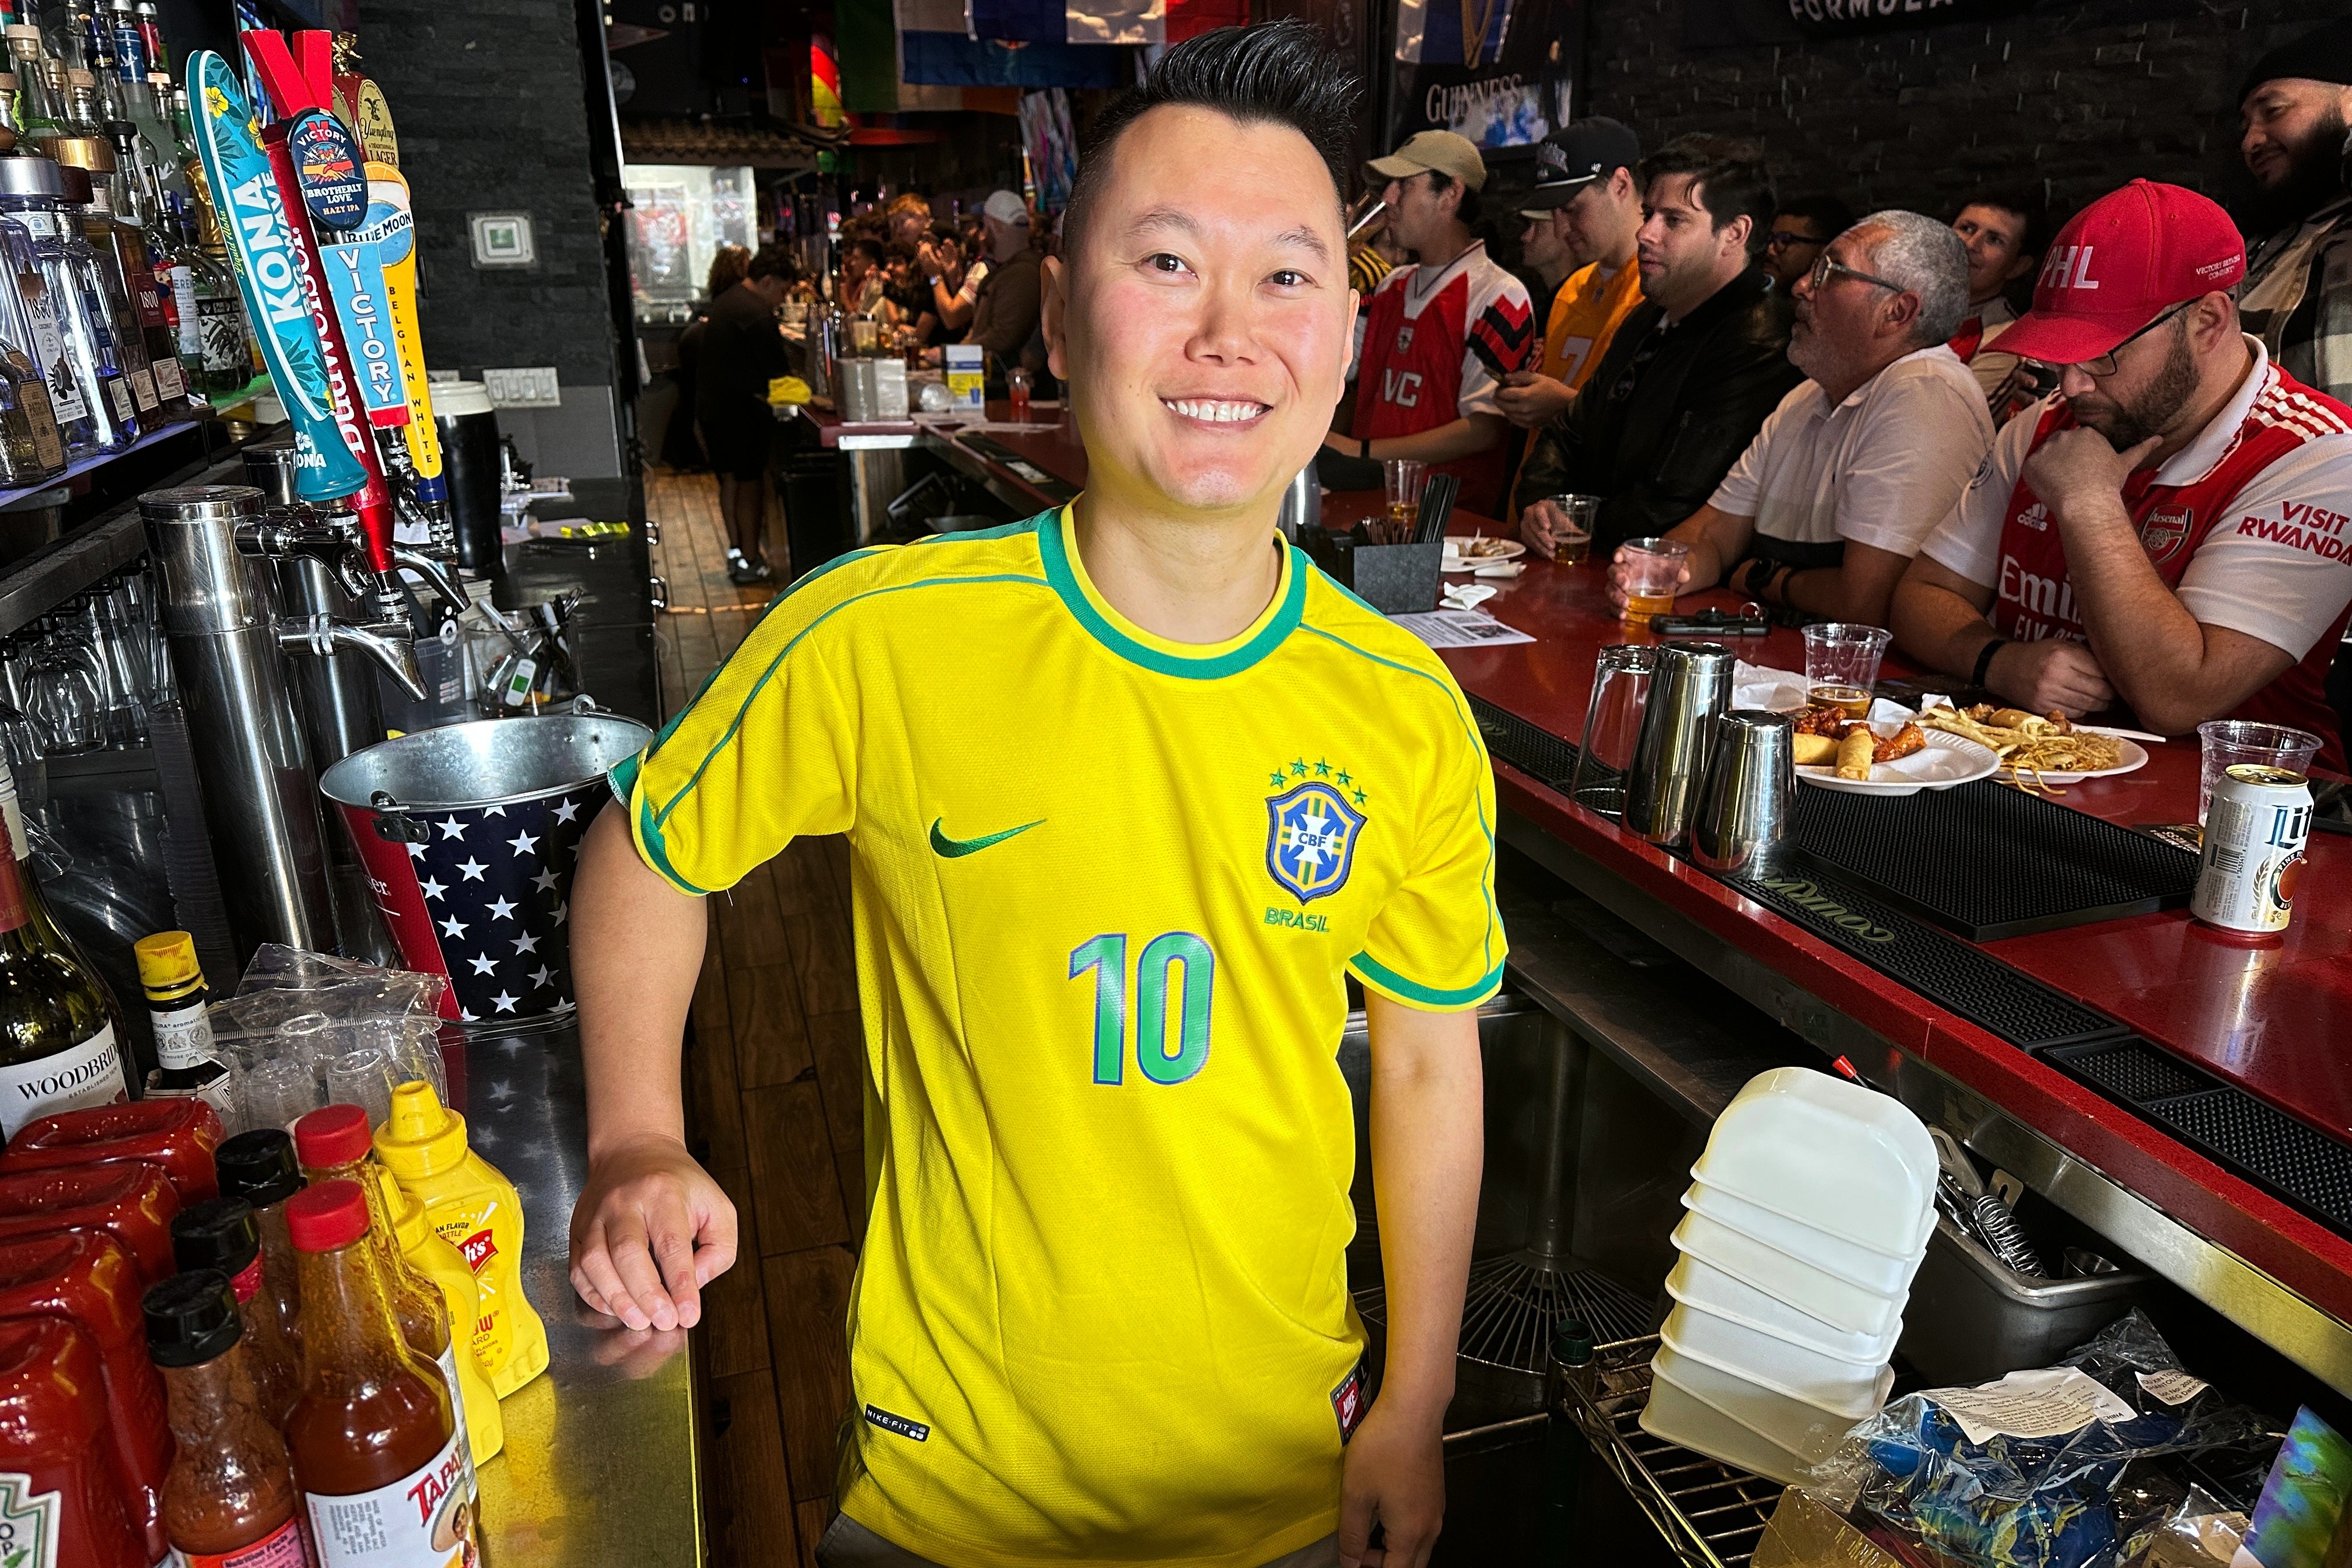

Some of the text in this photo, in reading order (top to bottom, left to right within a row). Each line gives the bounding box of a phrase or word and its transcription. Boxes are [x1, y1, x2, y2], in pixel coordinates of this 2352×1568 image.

[1789, 0, 1952, 21] FORMUL
[1426, 74, 1522, 123] GUINNESS
[297, 128, 347, 146] VICTORY
[359, 117, 394, 143] Yuengling
[369, 150, 398, 166] LAGER
[306, 183, 362, 198] BROTHERLY
[327, 192, 352, 204] LOVE
[323, 205, 360, 215] HAZY IPA
[383, 212, 412, 237] MOON
[232, 173, 306, 324] KONA
[2038, 246, 2099, 289] PHL
[139, 290, 159, 308] 1800
[337, 248, 391, 402] VICTORY
[1560, 335, 1594, 386] 7
[388, 286, 433, 463] BELGIAN WHITE
[2148, 511, 2186, 526] Arsenal
[2282, 501, 2350, 536] VISIT
[2236, 516, 2352, 567] RWANDA
[1298, 832, 1327, 847] CBF
[1264, 907, 1330, 933] BRASIL
[1068, 931, 1215, 1086] 10
[68, 1074, 110, 1099] ESTABLISHED
[446, 1222, 470, 1230] FLAVOR
[1343, 1389, 1355, 1416] NIKE
